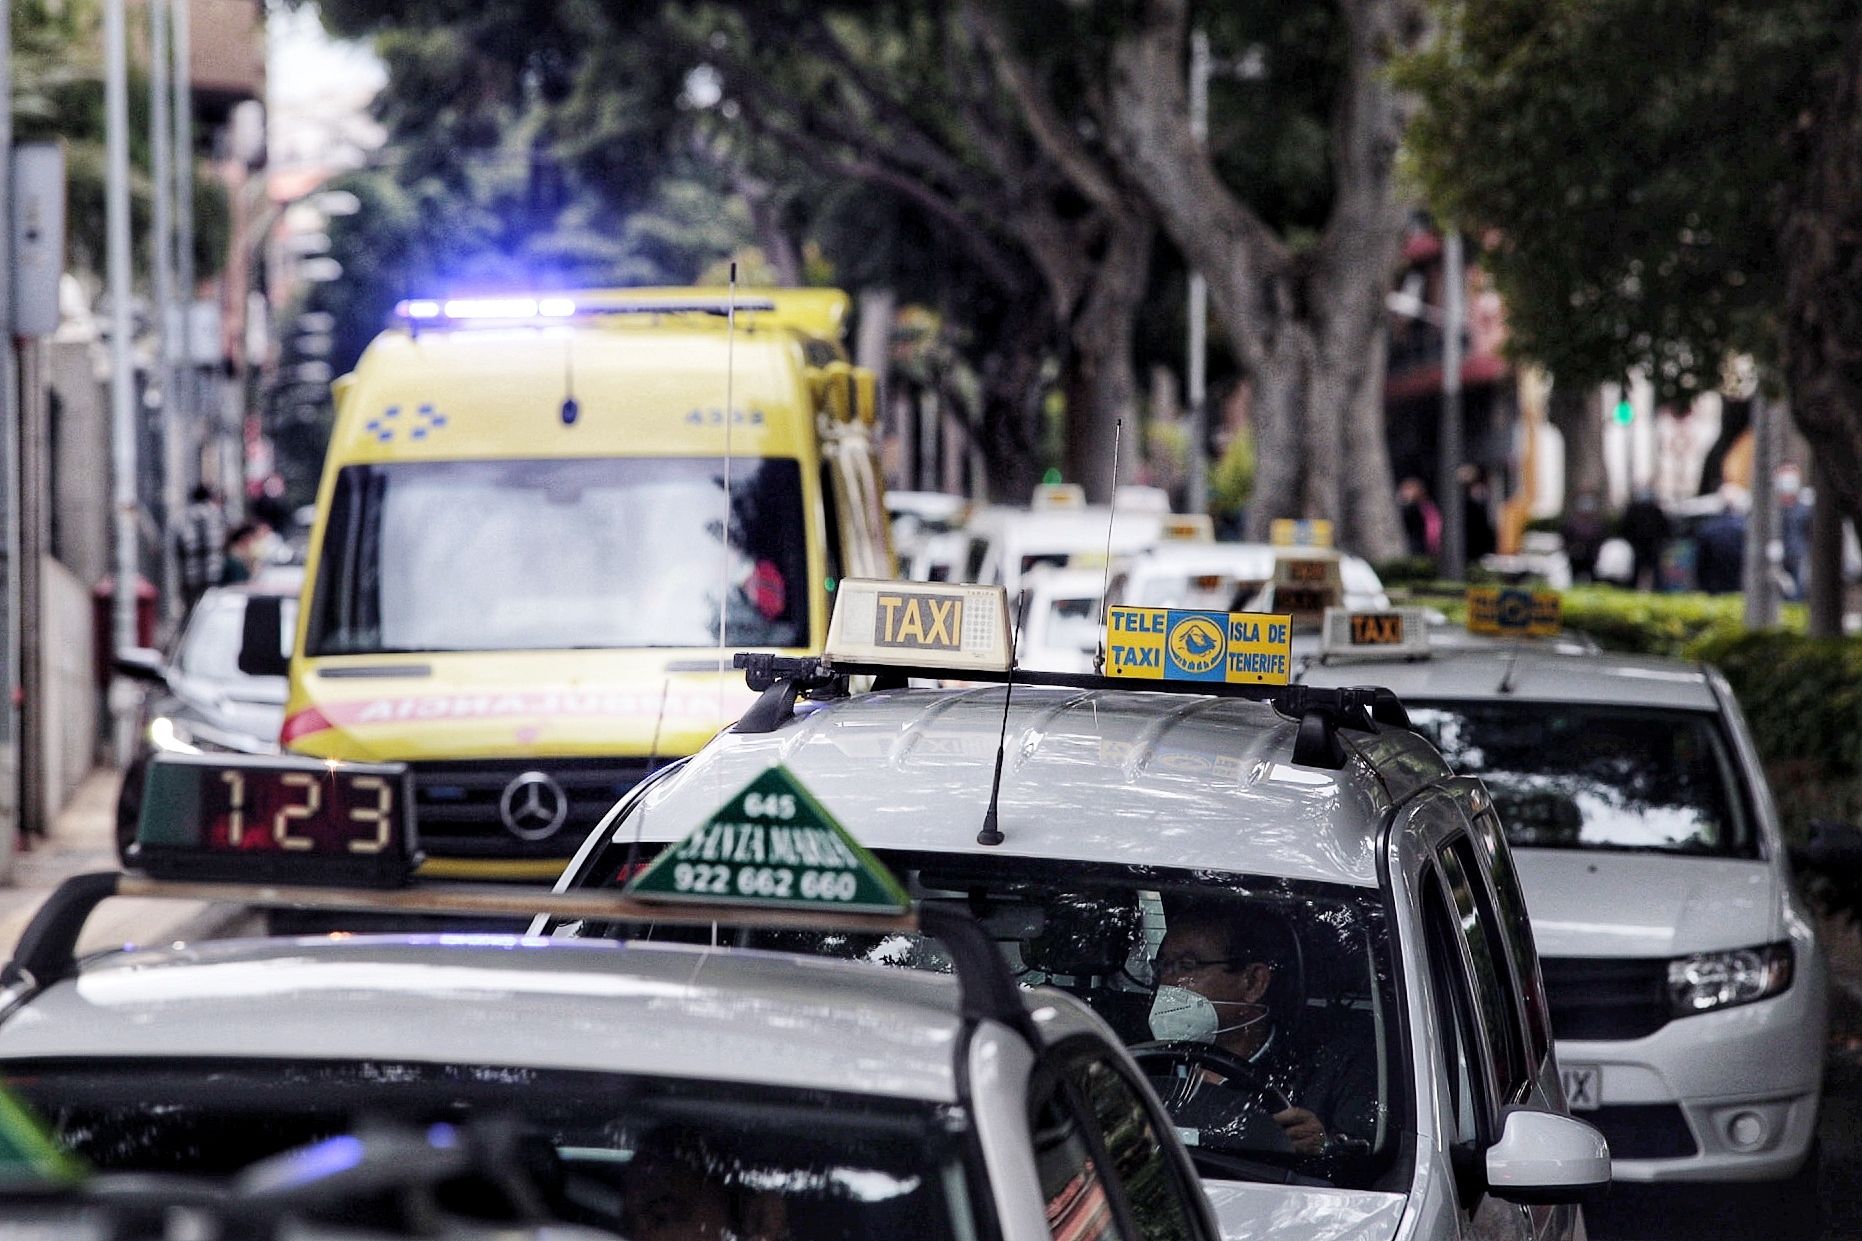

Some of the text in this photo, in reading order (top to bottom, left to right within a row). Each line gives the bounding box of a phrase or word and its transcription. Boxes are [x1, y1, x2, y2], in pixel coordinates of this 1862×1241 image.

[878, 596, 963, 647] TAXI
[1111, 612, 1165, 634] TELE
[1230, 621, 1287, 644] ISLA DE
[1353, 615, 1401, 644] TAXI
[1111, 645, 1161, 668] TAXI
[1229, 652, 1286, 675] TENERIFE
[222, 769, 393, 854] 123
[743, 792, 796, 821] 645
[673, 862, 858, 901] 922 662 660
